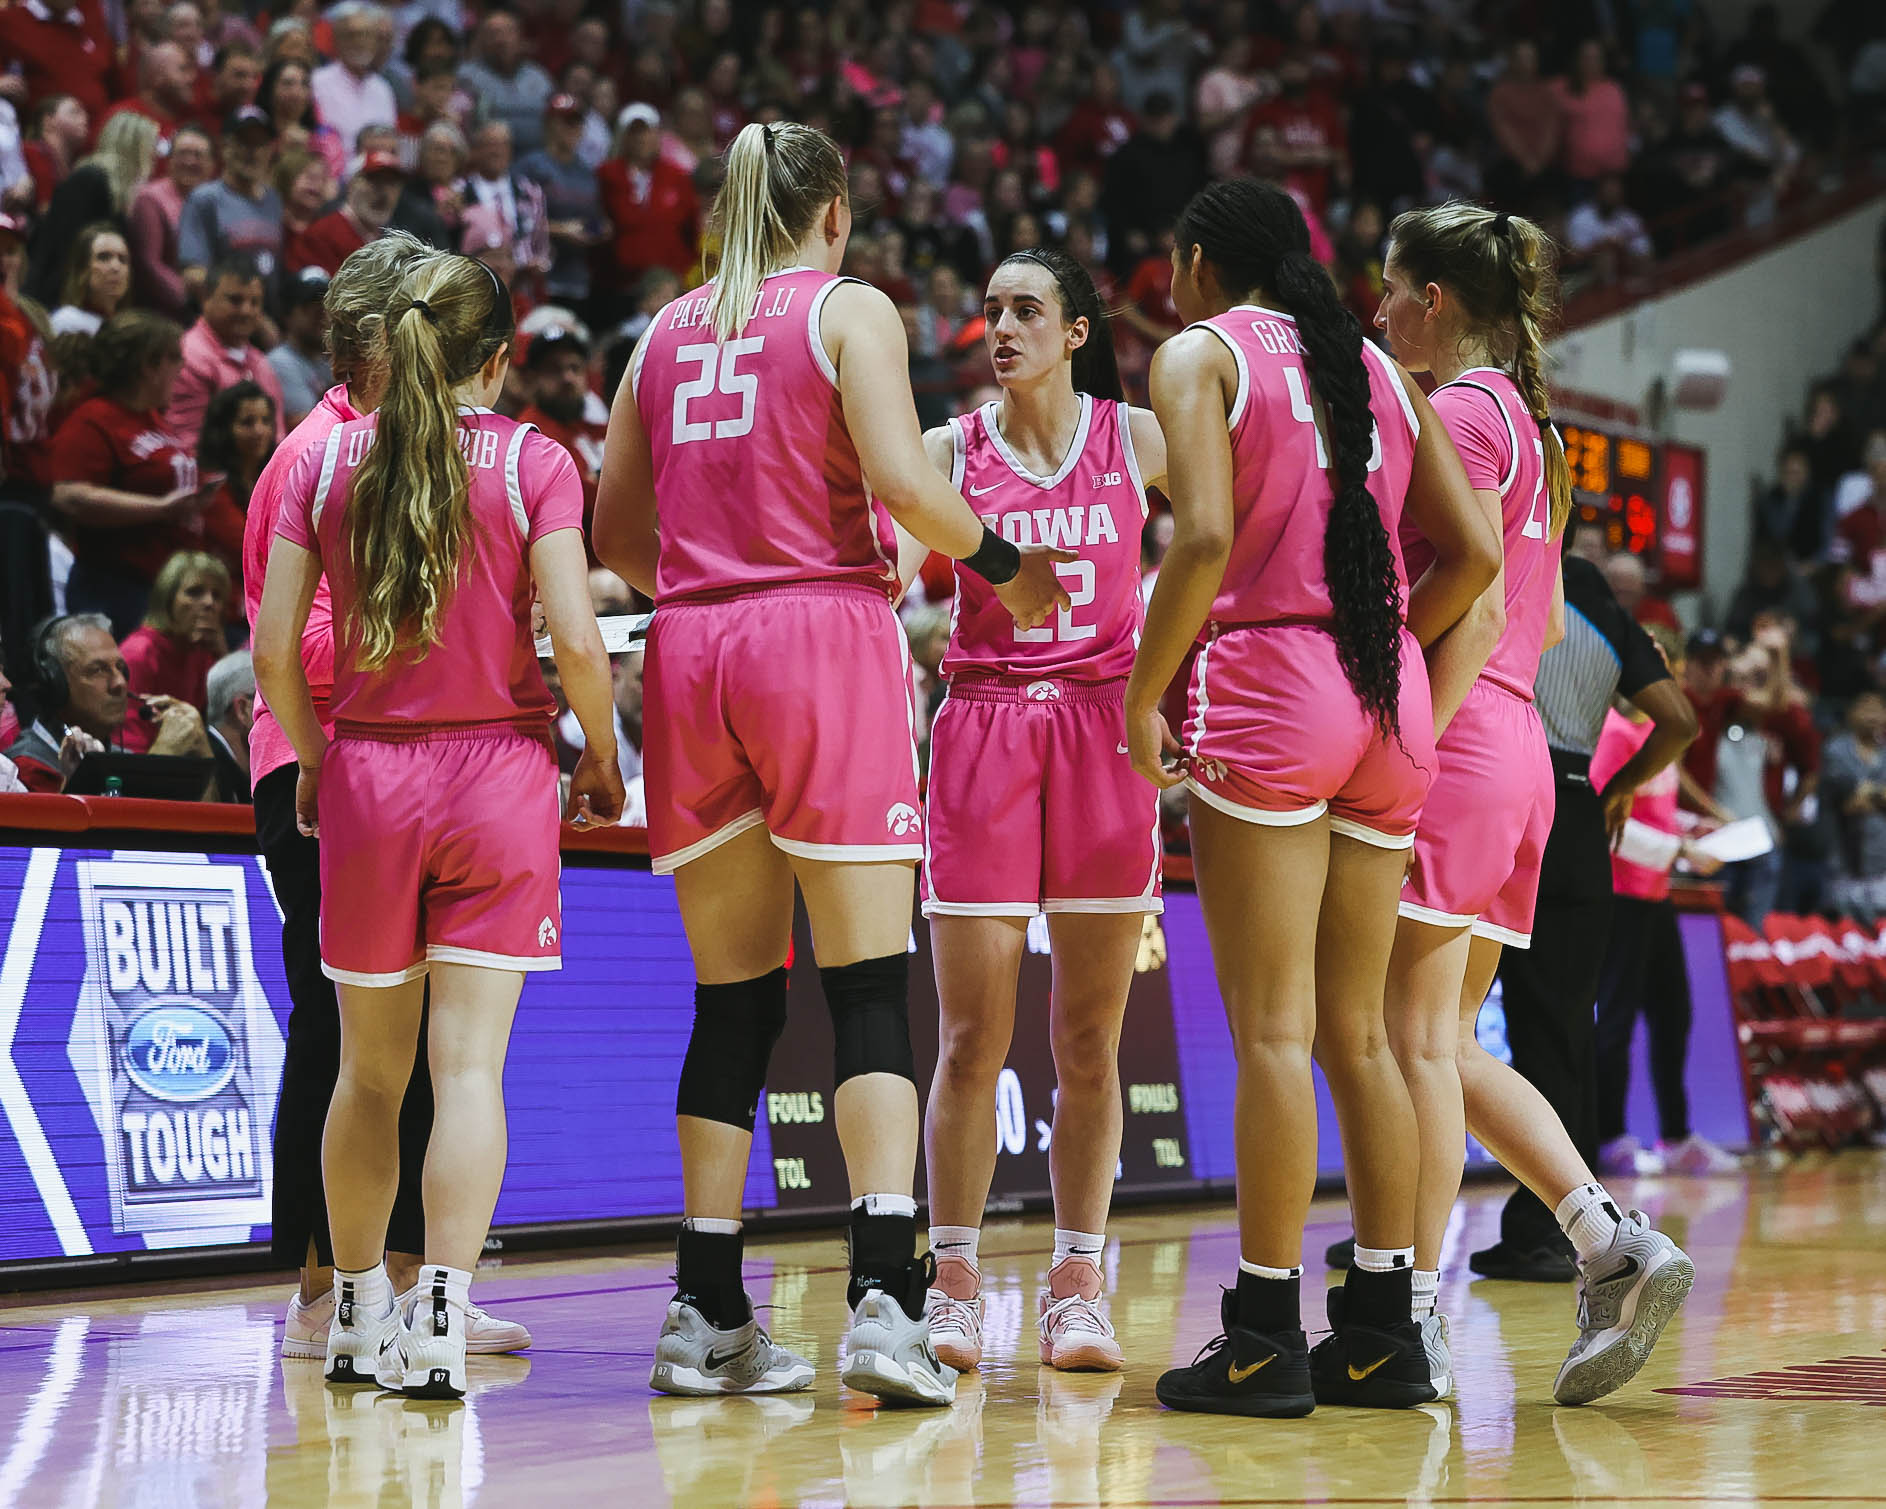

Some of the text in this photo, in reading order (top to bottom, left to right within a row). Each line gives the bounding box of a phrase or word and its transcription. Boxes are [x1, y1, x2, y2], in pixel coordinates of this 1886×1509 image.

[765, 287, 798, 318] JJ
[672, 335, 766, 445] 25
[981, 503, 1120, 548] IOWA
[101, 900, 235, 994] BUILT
[146, 1020, 211, 1075] Ford
[767, 1091, 825, 1125] FOULS
[121, 1109, 256, 1185] TOUGH
[773, 1157, 812, 1190] TOL
[337, 1359, 349, 1369] 07
[657, 1366, 668, 1377] 07
[858, 1354, 871, 1365] 07
[434, 1372, 446, 1383] 07
